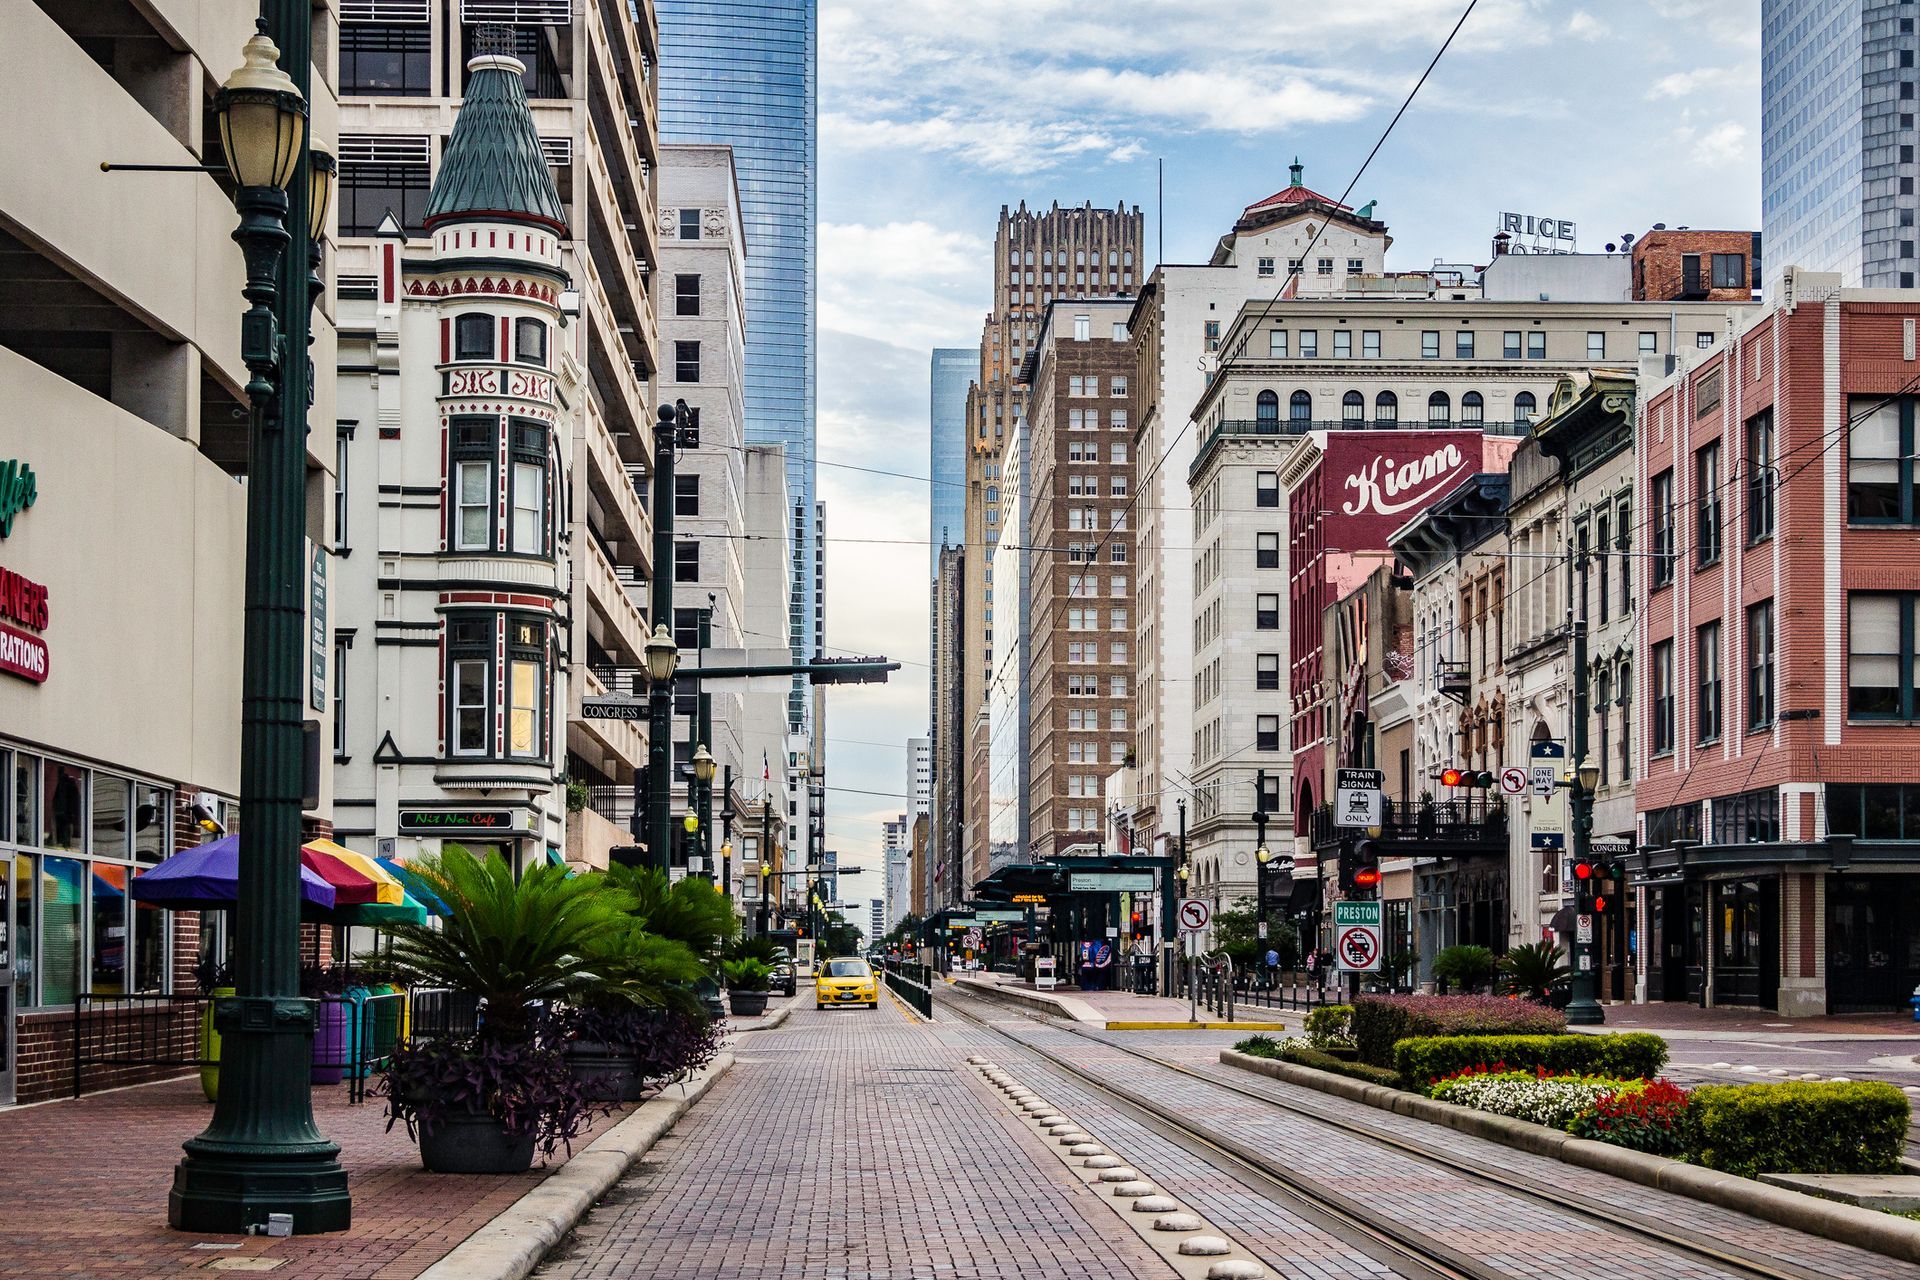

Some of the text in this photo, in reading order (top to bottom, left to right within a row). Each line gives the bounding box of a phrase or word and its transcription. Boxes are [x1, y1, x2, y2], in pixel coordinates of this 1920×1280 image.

[1504, 212, 1574, 241] RICE
[1342, 443, 1469, 517] Kiam
[583, 706, 638, 719] CONGRESS
[1345, 771, 1375, 780] TRAIN
[1536, 769, 1552, 777] ONE
[1341, 780, 1378, 789] SIGNAL
[415, 813, 440, 824] Nit
[445, 813, 470, 824] Noi
[1345, 814, 1372, 823] ONLY
[1591, 843, 1629, 853] CONGRESS
[1338, 906, 1378, 920] PRESTON
